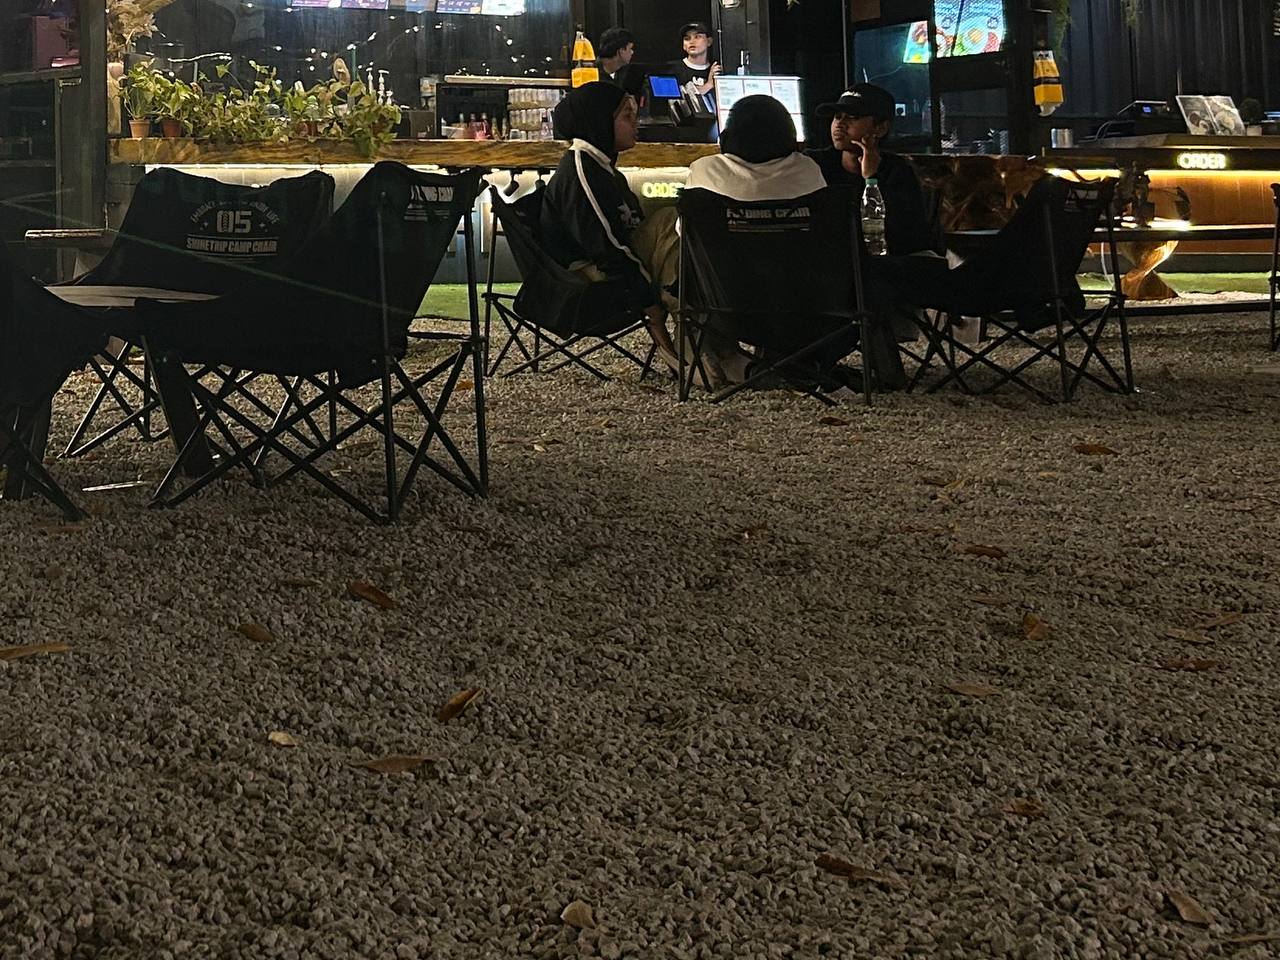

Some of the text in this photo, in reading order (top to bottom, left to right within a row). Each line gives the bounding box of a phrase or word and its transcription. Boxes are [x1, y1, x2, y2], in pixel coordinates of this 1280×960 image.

[1177, 152, 1226, 169] ORDER
[642, 182, 684, 198] ORDE
[216, 210, 253, 233] 05
